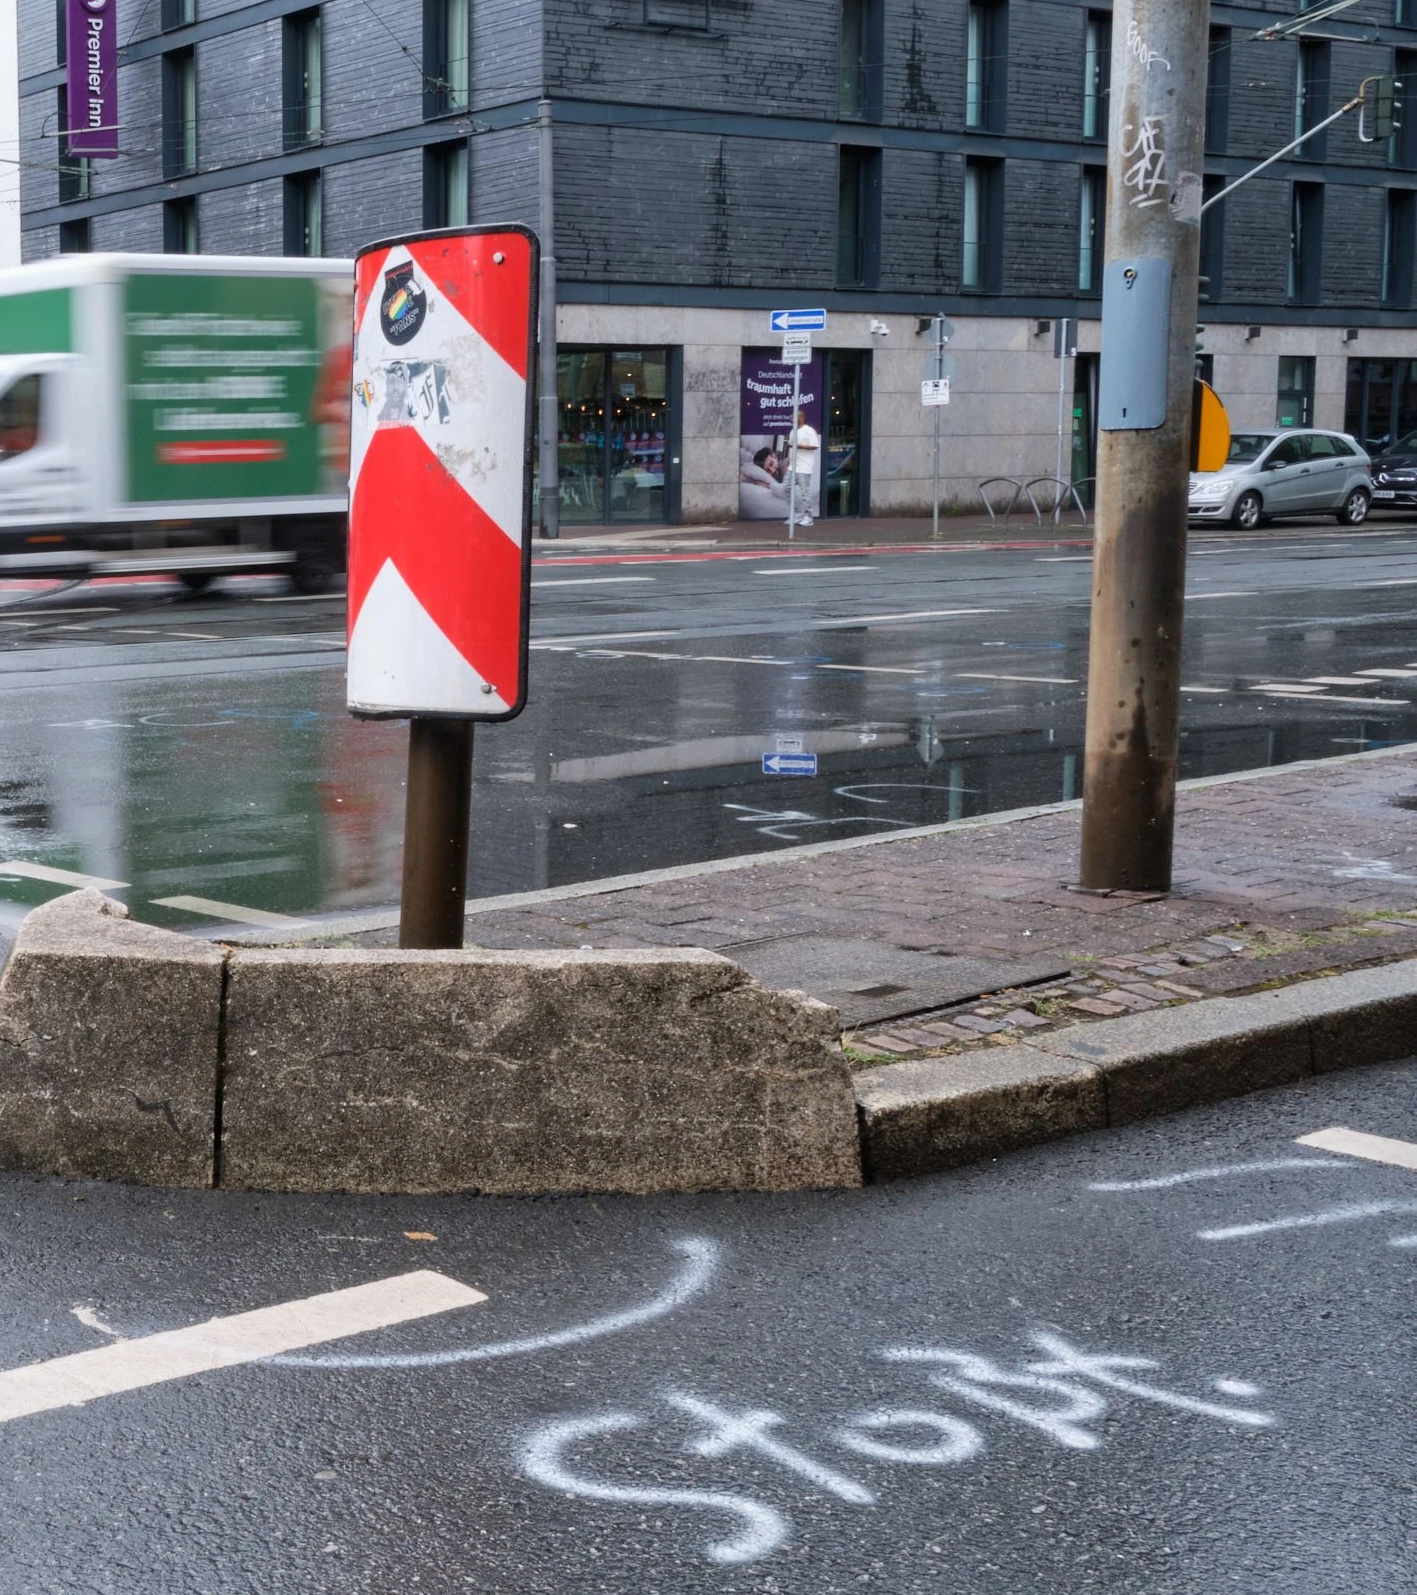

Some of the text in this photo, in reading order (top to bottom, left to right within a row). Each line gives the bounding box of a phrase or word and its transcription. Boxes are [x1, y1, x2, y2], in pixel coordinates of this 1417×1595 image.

[87, 18, 103, 94] Premier
[746, 378, 792, 395] traumhaft
[760, 396, 776, 409] gut
